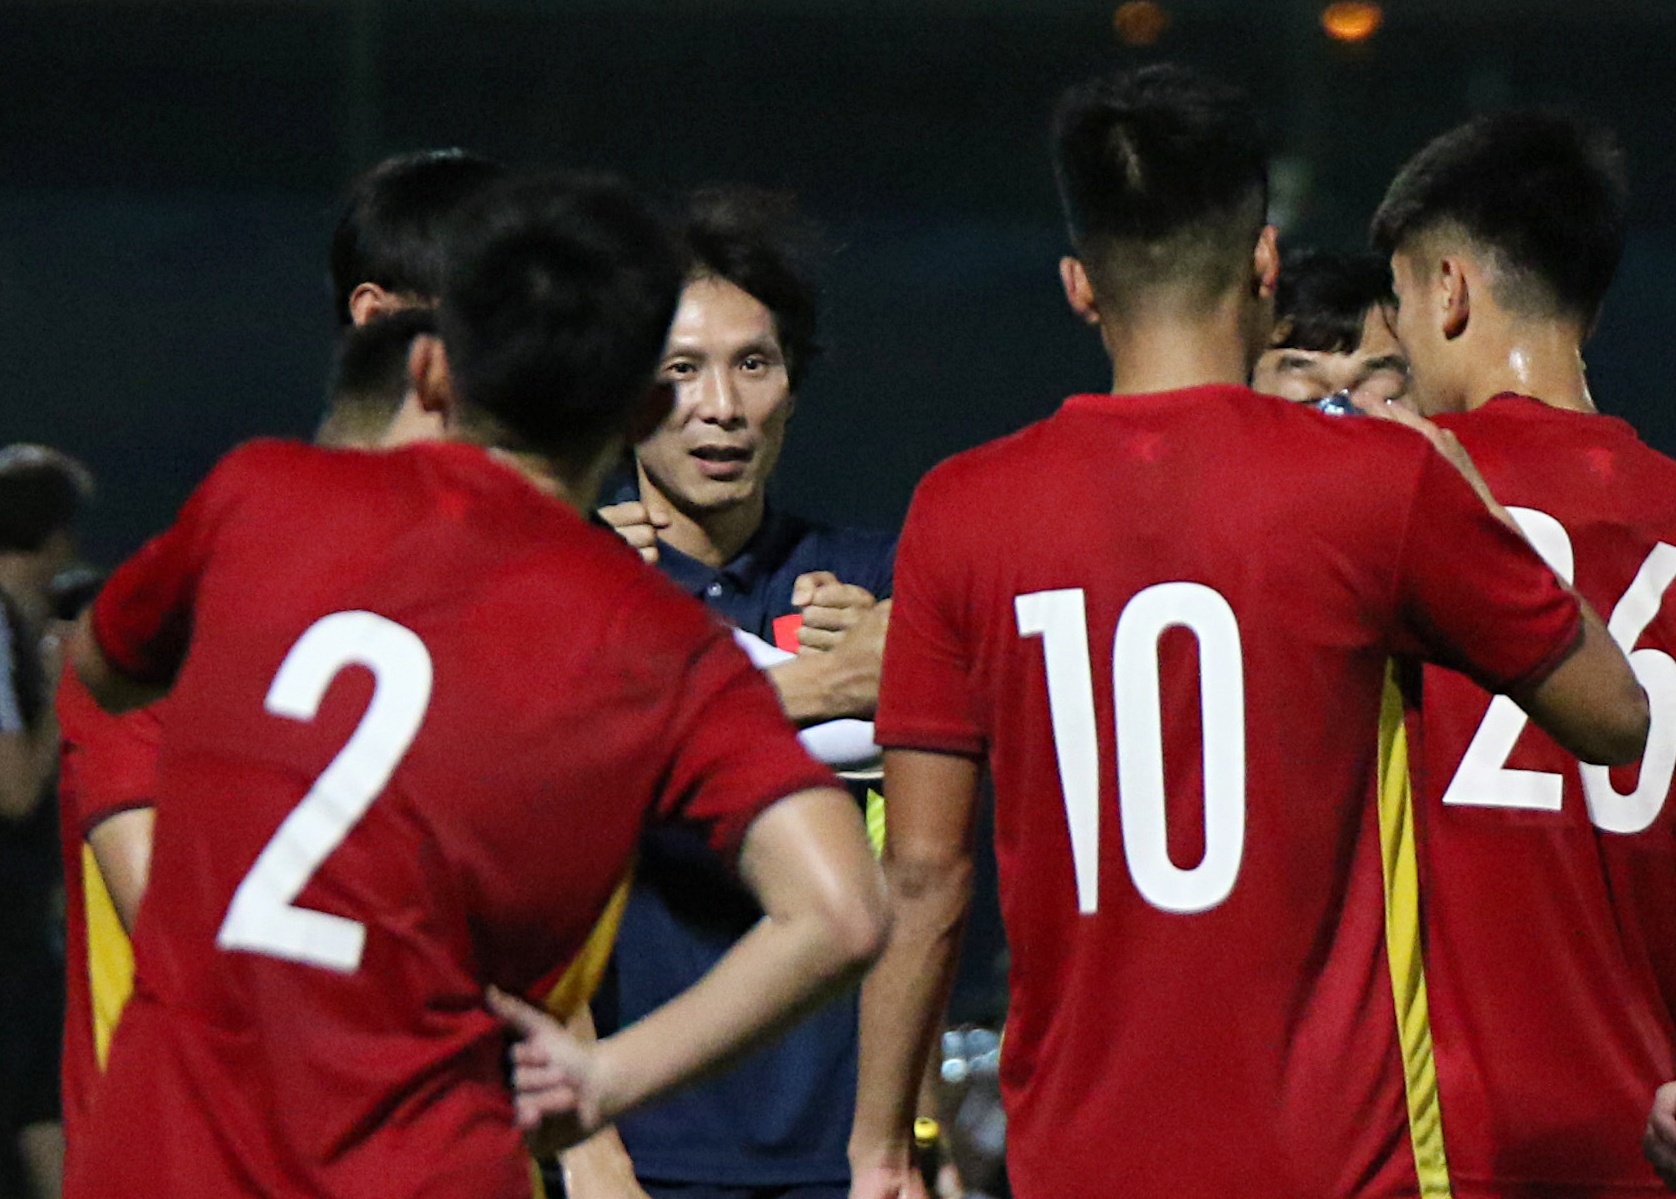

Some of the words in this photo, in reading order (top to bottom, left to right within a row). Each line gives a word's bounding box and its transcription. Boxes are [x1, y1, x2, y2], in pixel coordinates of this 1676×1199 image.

[217, 610, 434, 973] 2
[1014, 582, 1246, 916] 10
[1442, 506, 1676, 834] 26
